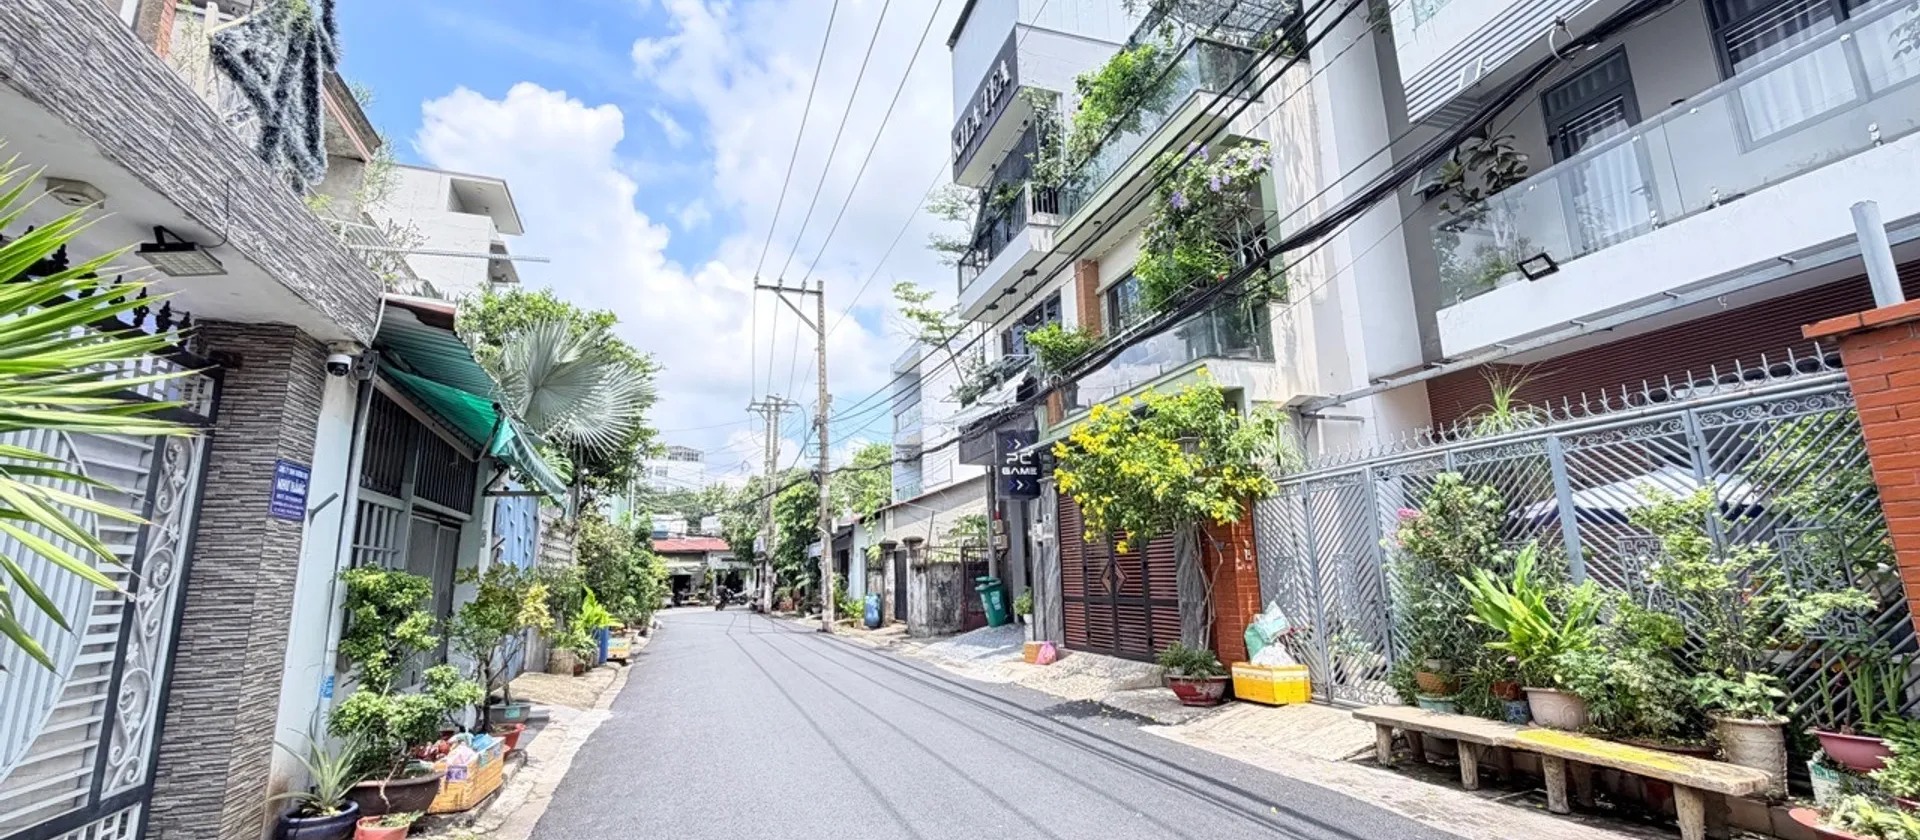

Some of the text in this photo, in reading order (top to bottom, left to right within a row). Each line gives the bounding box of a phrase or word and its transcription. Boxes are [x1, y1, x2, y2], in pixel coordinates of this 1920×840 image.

[981, 60, 1010, 115] TEA
[1006, 452, 1032, 465] PC
[1002, 467, 1037, 475] GAME
